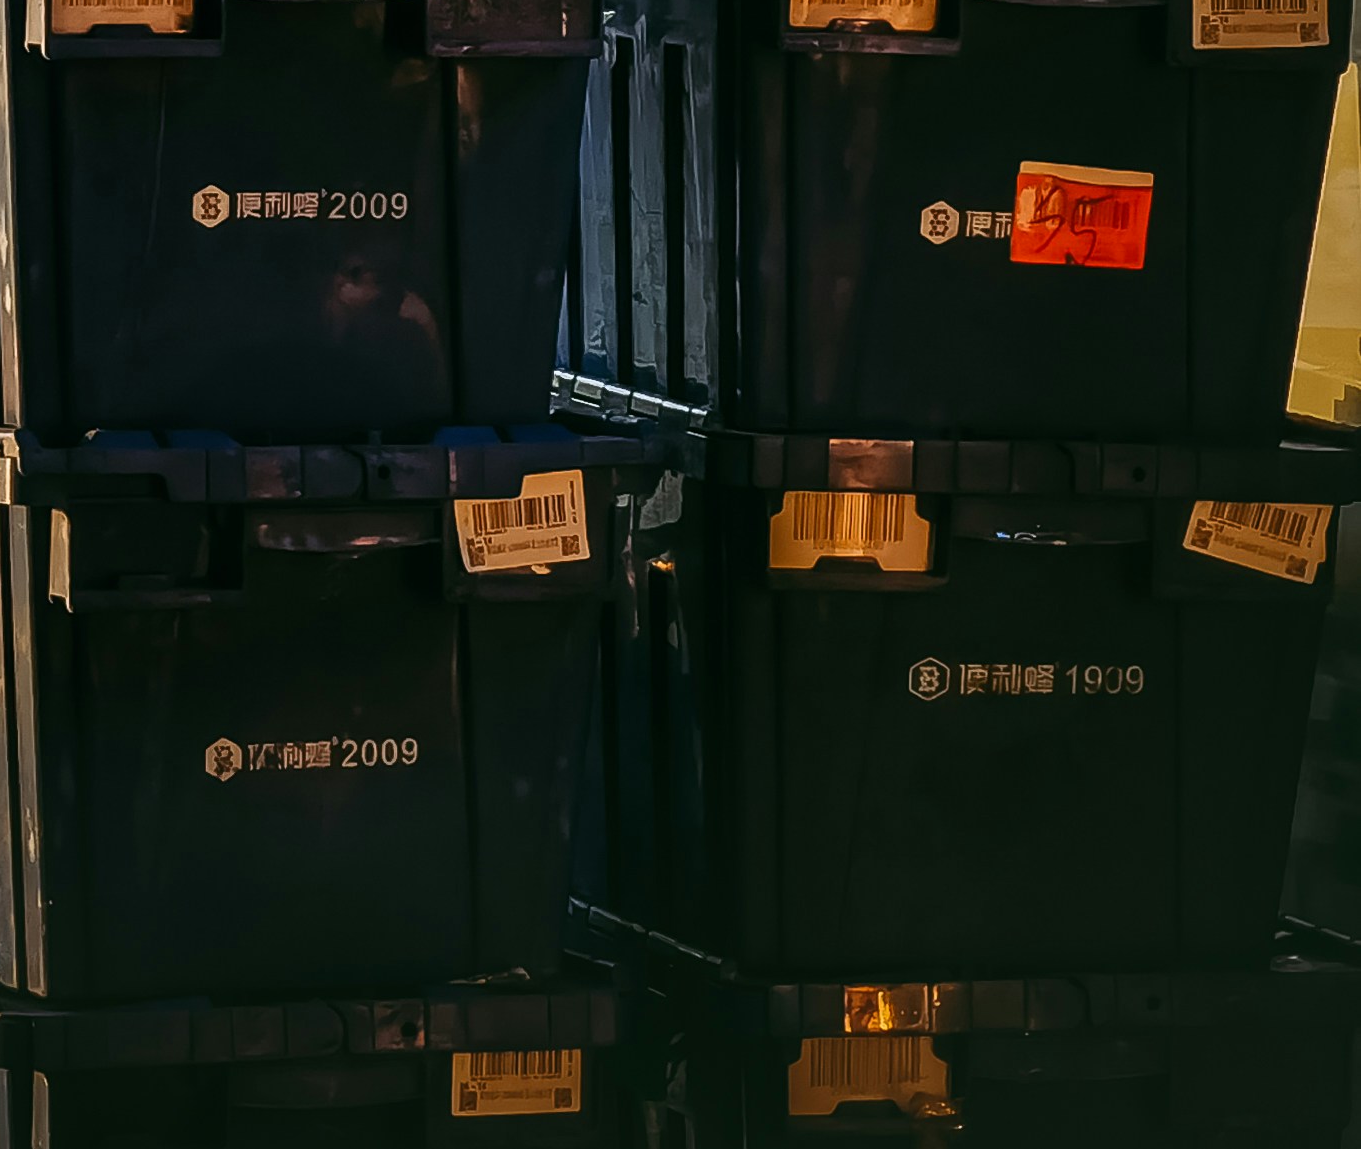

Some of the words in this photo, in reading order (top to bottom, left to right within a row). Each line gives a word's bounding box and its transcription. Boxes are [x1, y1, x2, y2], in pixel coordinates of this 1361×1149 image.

[236, 192, 319, 219] 便利蜂
[328, 192, 408, 220] 2009
[960, 663, 1054, 695] 便利蜂
[1066, 665, 1144, 694] 1909
[341, 738, 418, 767] 2009
